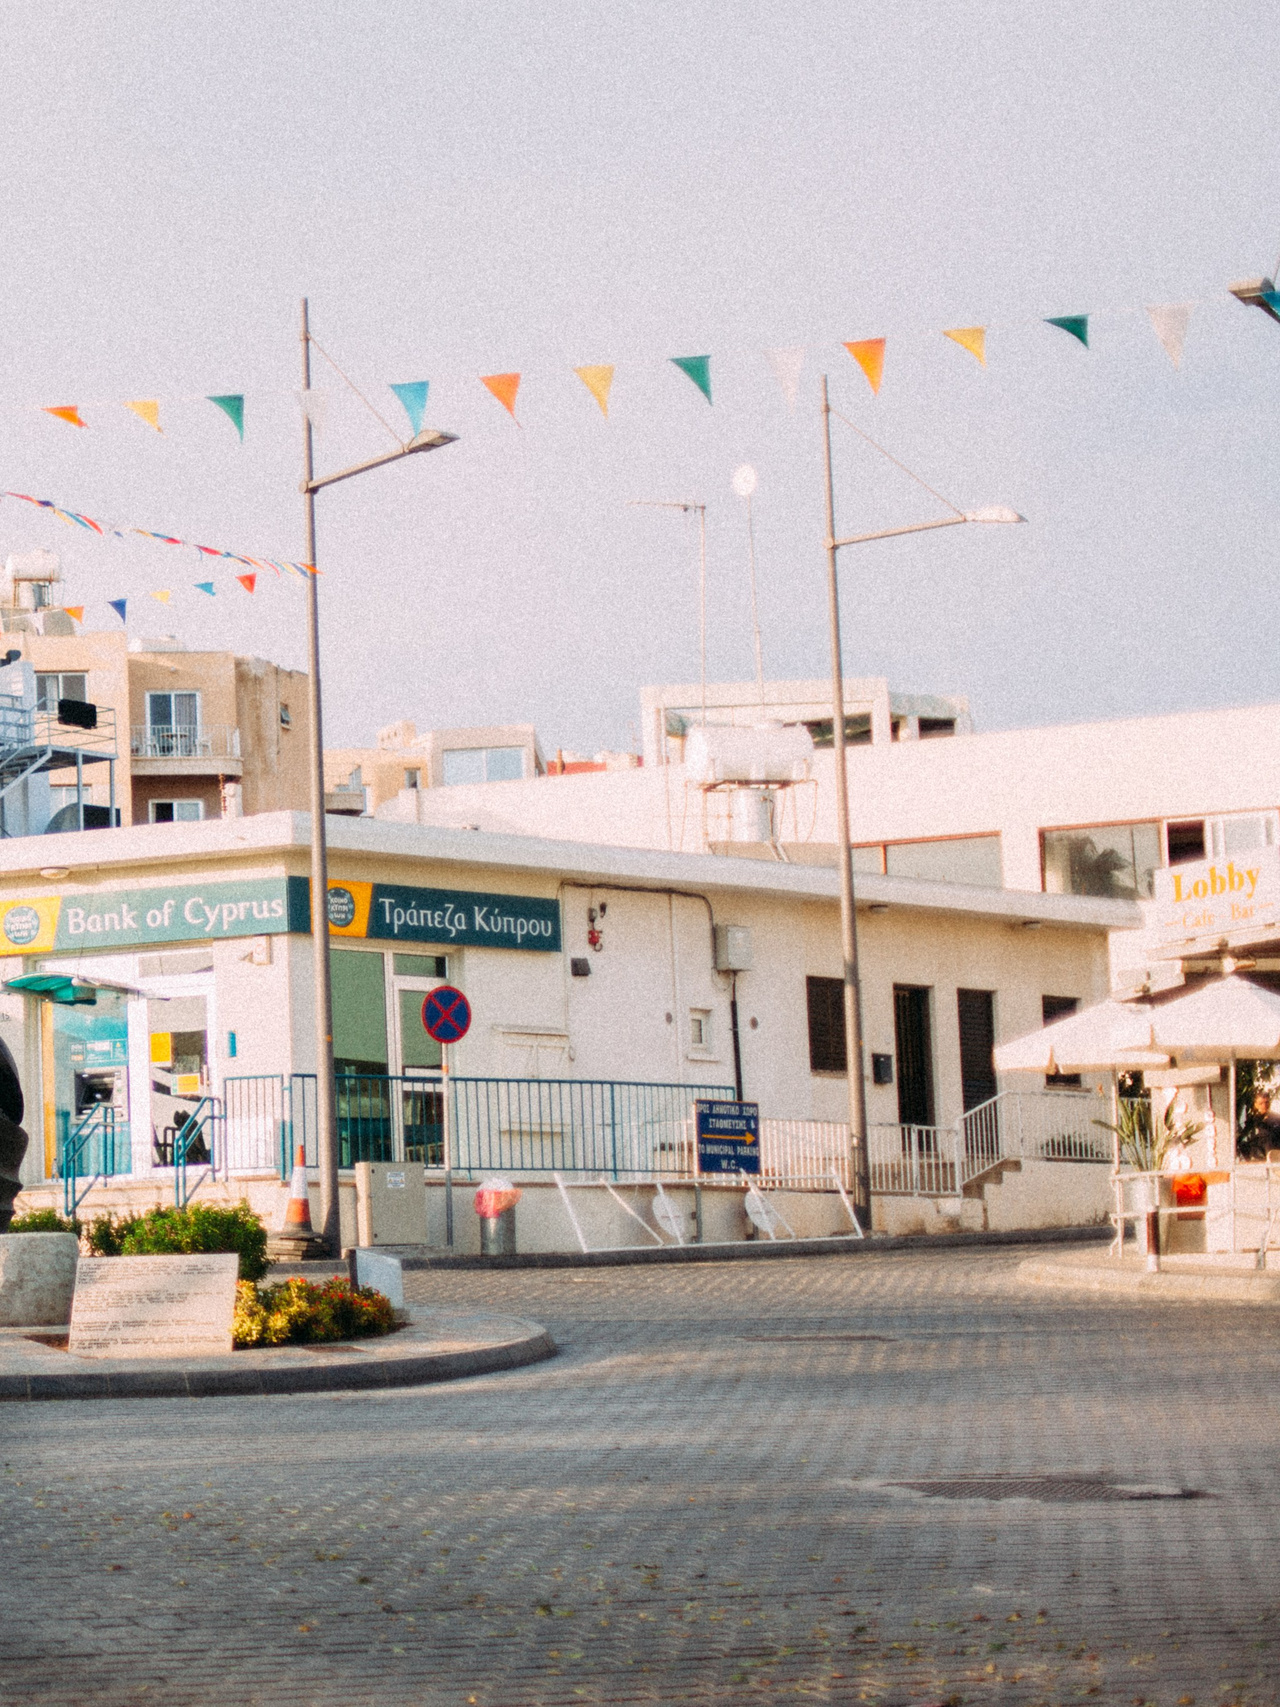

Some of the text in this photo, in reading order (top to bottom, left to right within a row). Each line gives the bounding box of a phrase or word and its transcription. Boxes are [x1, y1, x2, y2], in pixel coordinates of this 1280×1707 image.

[1173, 862, 1261, 903] Lobby
[67, 897, 283, 934] Bank of Cyprus
[379, 898, 552, 943] Τράπεζα Κύπρου
[1231, 903, 1254, 921] Bar
[706, 1144, 734, 1155] MUNICIPAL
[737, 1146, 759, 1156] PARKING
